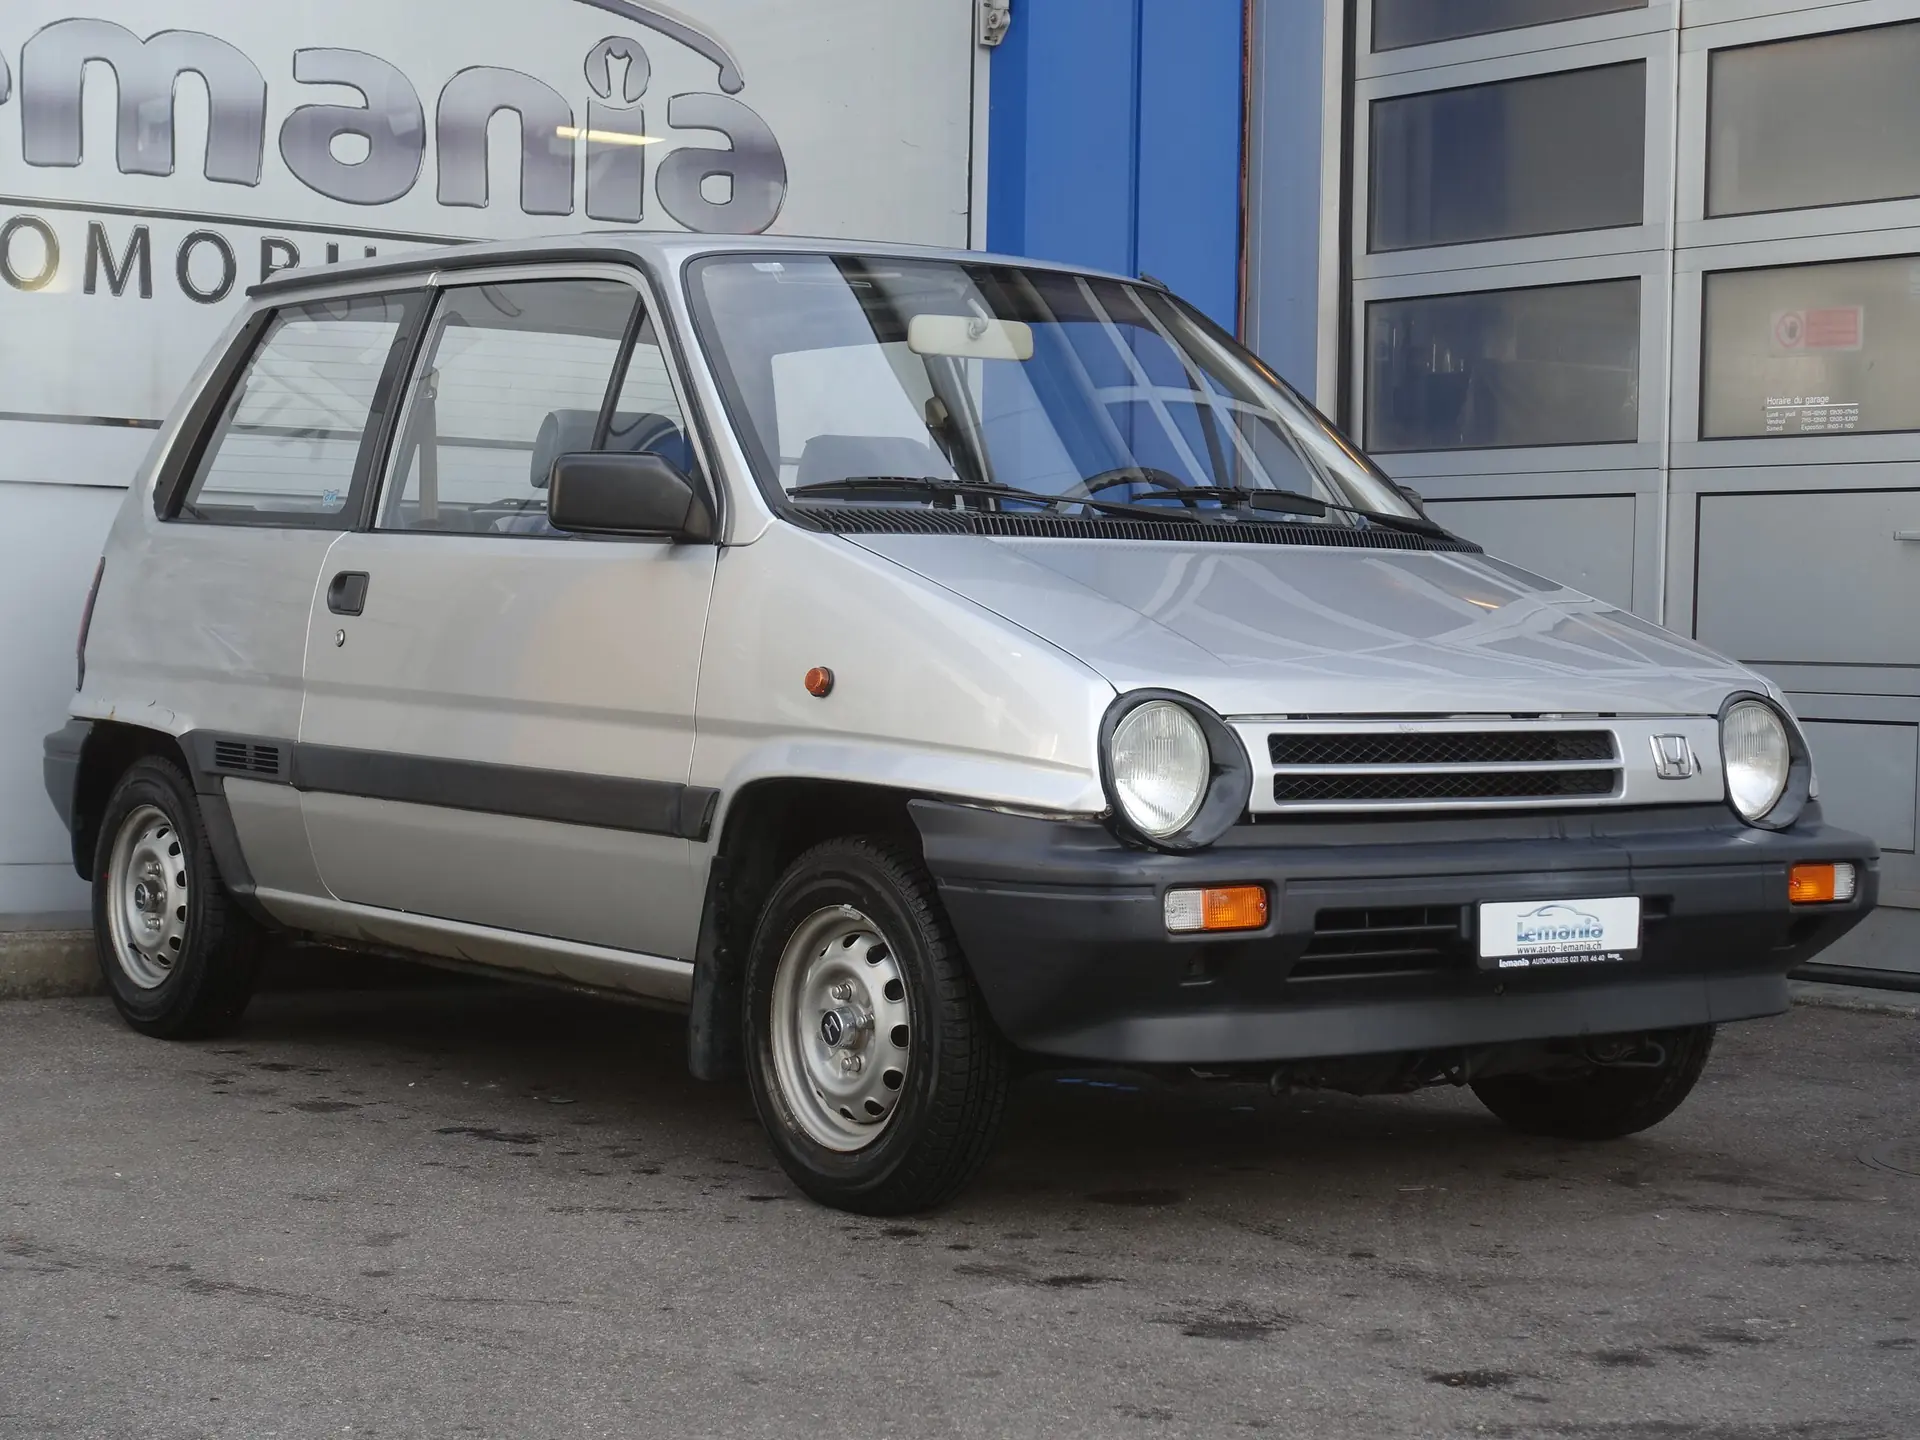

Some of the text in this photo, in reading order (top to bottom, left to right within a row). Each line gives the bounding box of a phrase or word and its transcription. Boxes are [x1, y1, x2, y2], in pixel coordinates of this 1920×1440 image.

[0, 17, 787, 234] mania
[1766, 396, 1830, 406] Horaire du garage
[1516, 918, 1604, 943] Lemania
[1516, 942, 1602, 954] www.auto-lemania.ch
[1531, 955, 1569, 965] AUTOMOBILES
